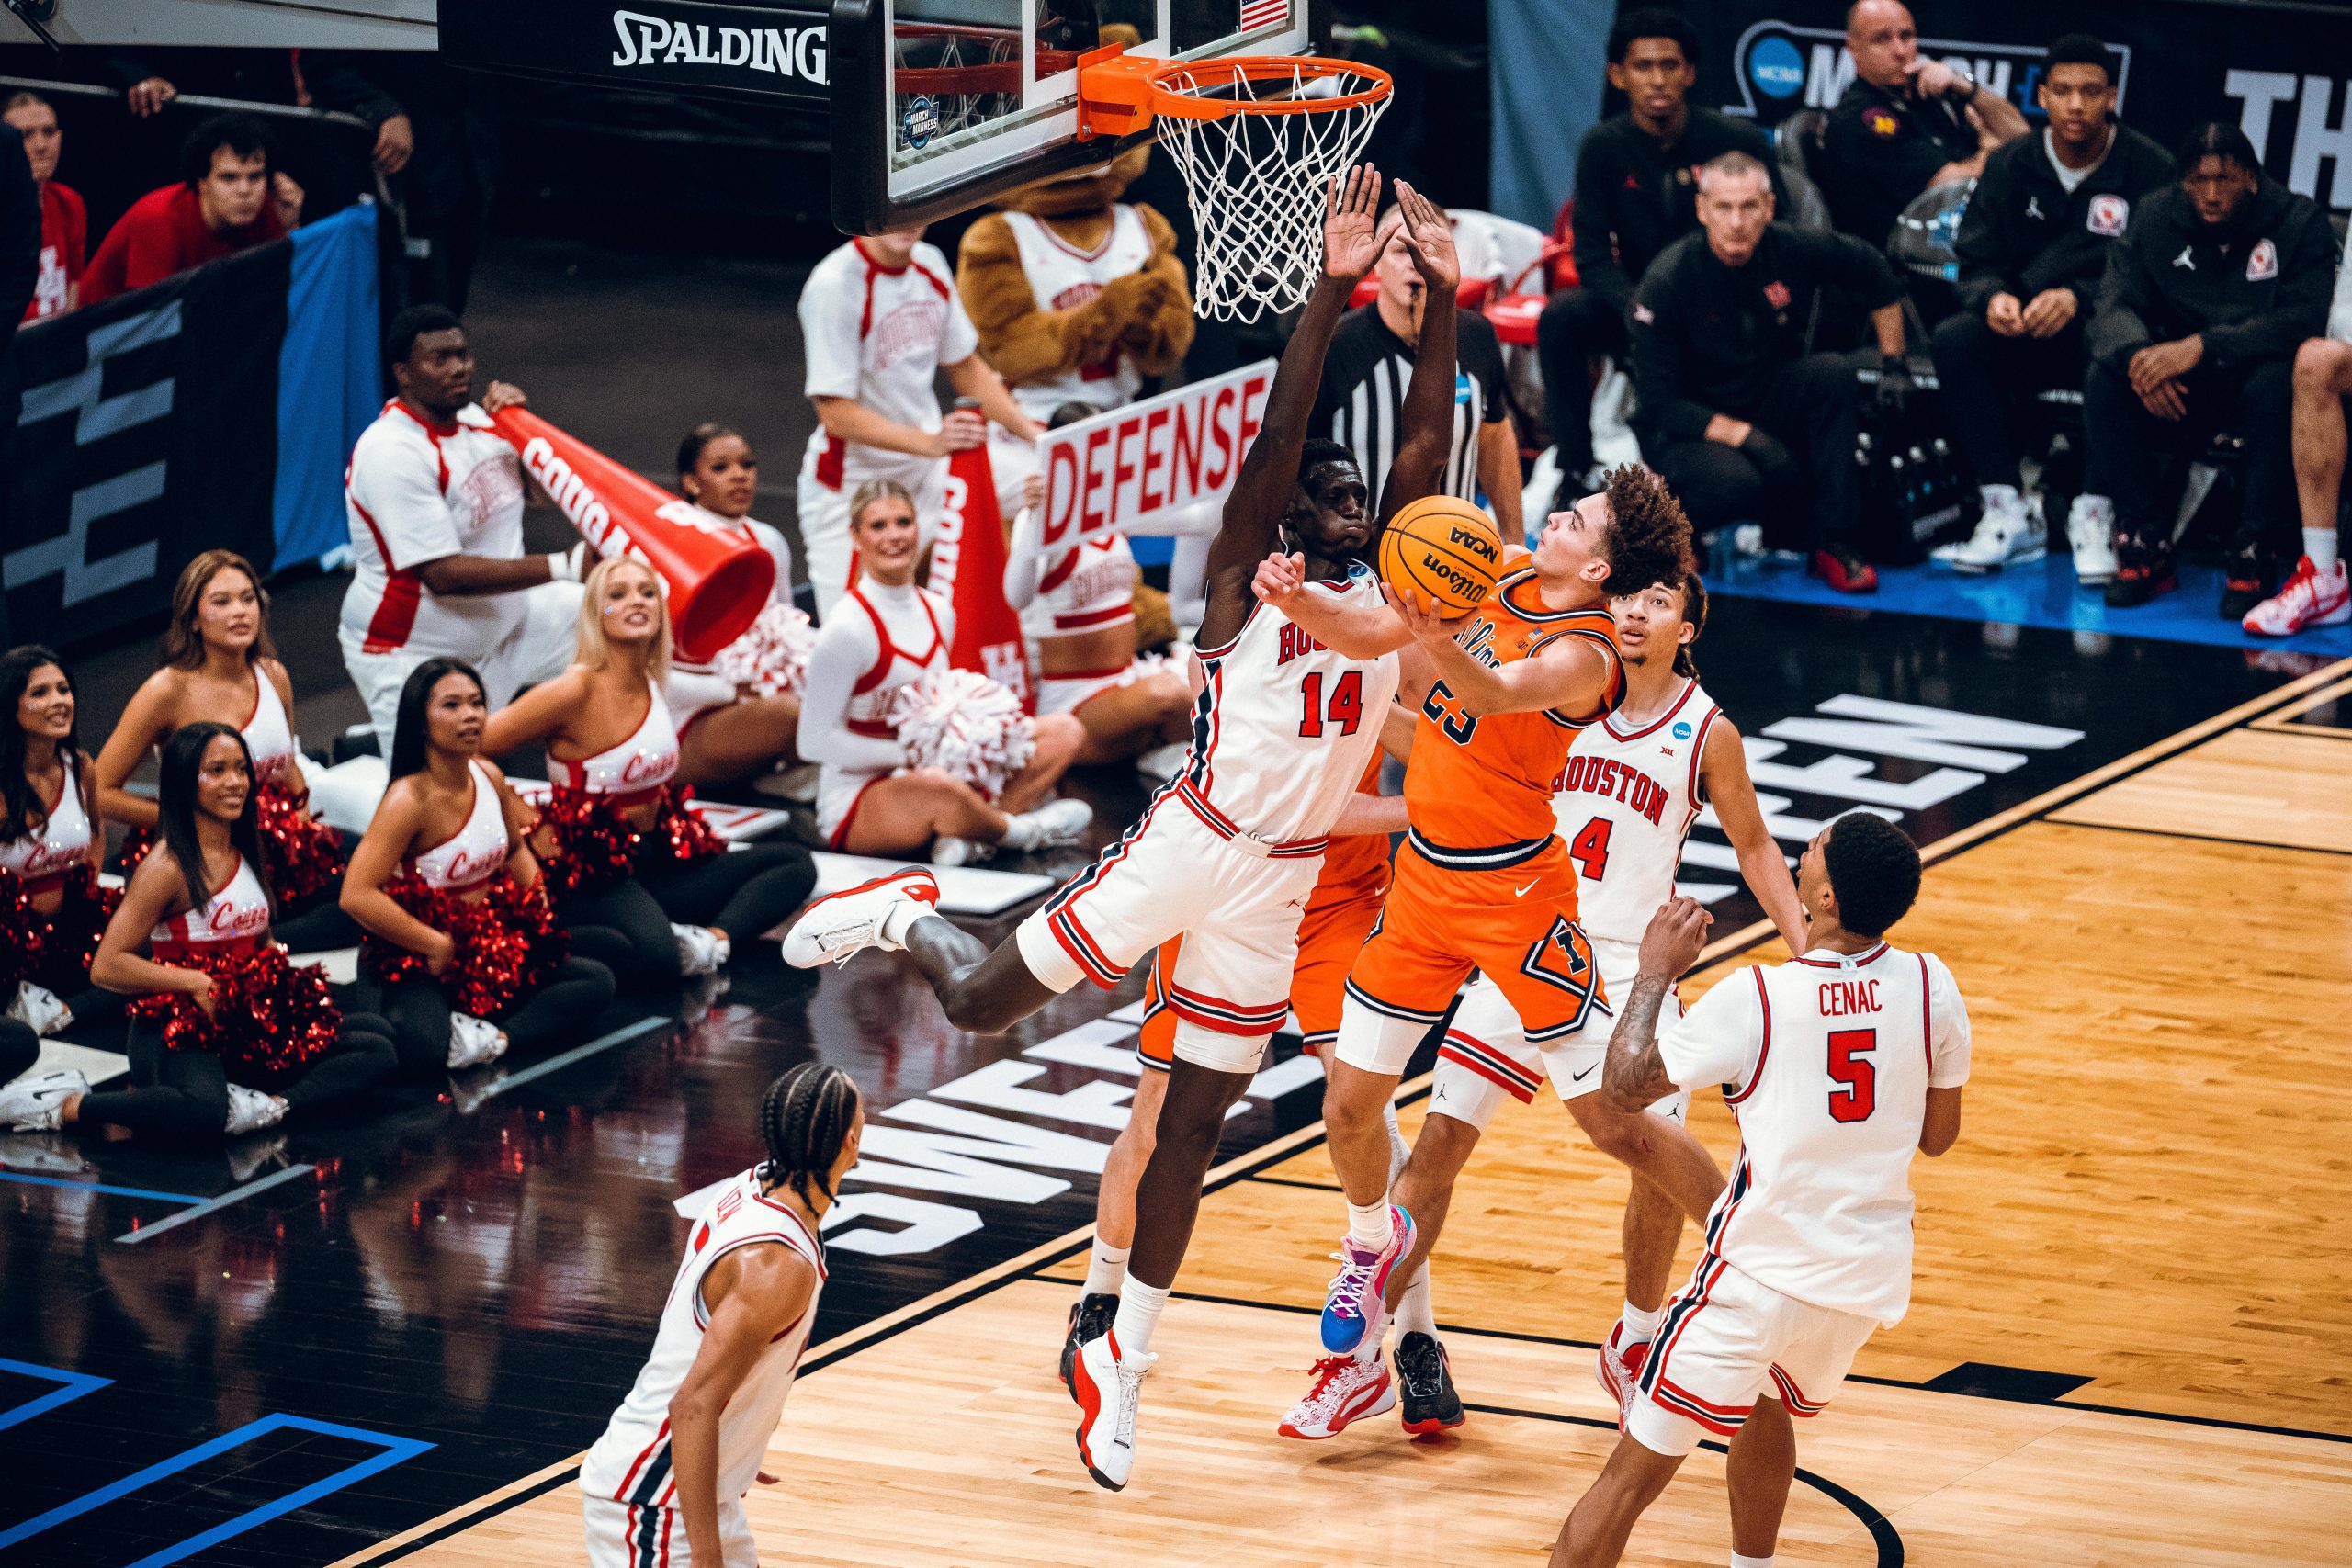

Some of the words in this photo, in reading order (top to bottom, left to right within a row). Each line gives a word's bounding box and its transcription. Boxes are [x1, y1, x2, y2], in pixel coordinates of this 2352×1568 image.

[613, 10, 827, 85] SPALDING
[910, 109, 929, 126] MARCH
[911, 117, 938, 136] MADNESS
[1044, 376, 1265, 547] DEFENSE
[1449, 526, 1498, 565] NCAA
[1422, 552, 1488, 604] Wilson
[1298, 671, 1363, 739] 14
[1570, 816, 1614, 883] 4
[1818, 978, 1883, 1017] CENAC
[1826, 1027, 1877, 1124] 5
